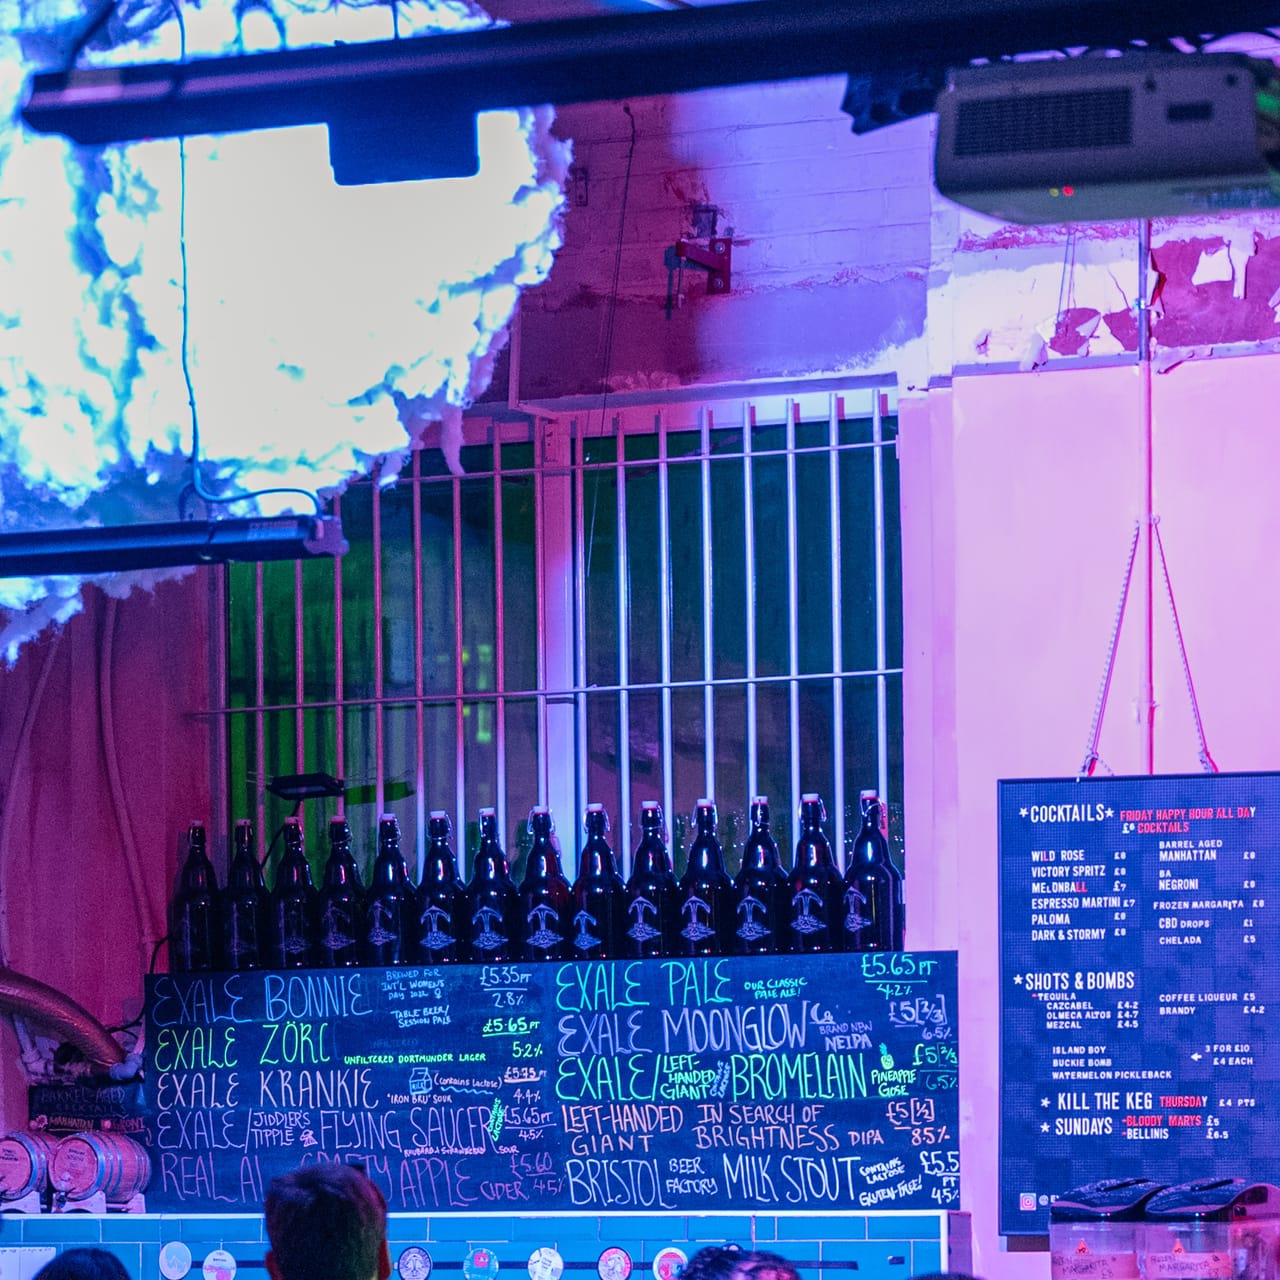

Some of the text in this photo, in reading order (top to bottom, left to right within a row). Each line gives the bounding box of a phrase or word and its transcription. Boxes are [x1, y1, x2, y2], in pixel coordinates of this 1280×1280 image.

[1030, 804, 1256, 823] COCKTAILS FRIDAY HAPPY HOUR ALL DAY
[1138, 822, 1190, 834] COCKTAILS
[1159, 840, 1223, 850] BARREL AGED
[1031, 849, 1085, 862] WILD ROSE
[1159, 850, 1216, 862] MANHATTAN
[1031, 865, 1106, 878] VICTORY SPRITZ
[1159, 870, 1172, 878] BA
[1113, 880, 1126, 892] £7
[1158, 878, 1199, 890] NEGRONI
[1031, 896, 1136, 910] ESPRESSO MARTINI £7
[1153, 900, 1244, 910] FROZEN MARGARITA
[1031, 914, 1071, 926] PALOMA
[1158, 918, 1210, 930] CBD DROPS
[1031, 928, 1106, 942] DARK & STORMY
[1159, 936, 1202, 946] CHELADA
[423, 968, 441, 978] FOR
[861, 954, 916, 978] £5.65
[556, 958, 733, 1013] EXALE PALE
[744, 976, 809, 990] OUR CLASSIC
[1025, 970, 1136, 991] SHOTS & BOMBS
[152, 973, 373, 1027] EXALE BONNIE
[754, 986, 802, 1000] PALE ALE!
[1159, 992, 1256, 1003] COFFEE LIQUEUR £5
[1046, 1000, 1139, 1011] CAZCABEL £4.2
[1159, 1006, 1265, 1016] BRANDY £4.2
[390, 1008, 420, 1019] TABLE
[1046, 1010, 1139, 1020] OLMECA ALTOS £4.7
[398, 1014, 452, 1028] SESSION PALE
[820, 1020, 873, 1034] BRAND NEW
[1046, 1020, 1082, 1030] MEZCAL
[558, 1000, 811, 1058] EXALE MOONGLOW
[154, 1026, 238, 1072] EXALE
[824, 1033, 873, 1052] NEIPA
[1205, 1044, 1232, 1053] 3 FOR
[1052, 1046, 1106, 1055] ISLAND BOY
[344, 1052, 487, 1065] UNFILTERED DORTMUNDER LAGER
[1052, 1058, 1112, 1068] BUCKIE BOMB
[1213, 1057, 1254, 1066] £4 EACH
[668, 1069, 716, 1085] HANDED
[730, 1052, 868, 1102] BROMELAIN
[870, 1068, 917, 1086] PINEAPPLE
[1052, 1070, 1172, 1080] WATERMELON PICKLEBACK
[157, 1068, 380, 1110] EXALE KRANKIE
[660, 1083, 712, 1101] GIANT
[878, 1083, 910, 1098] GOSE
[432, 1094, 452, 1104] SOUR
[1058, 1092, 1256, 1111] KILL THE KEG THURSDAY PTS
[561, 1102, 825, 1135] LEFT-HANDED IN SEARCH OF
[1056, 1115, 1202, 1136] SUNDAYS MARYS
[320, 1106, 499, 1154] FLYING SAUCER
[250, 1128, 296, 1149] TIPPLE
[570, 1124, 884, 1156] GIANT BRIGHTNESS DIPA
[668, 1156, 706, 1175] BEER
[161, 1151, 239, 1203] REAL
[400, 1157, 479, 1208] APPLE
[480, 1180, 530, 1200] CIDER
[566, 1158, 678, 1210] BRISTOL
[722, 1152, 862, 1203] MILK STOUT
[666, 1177, 718, 1196] FACTORY
